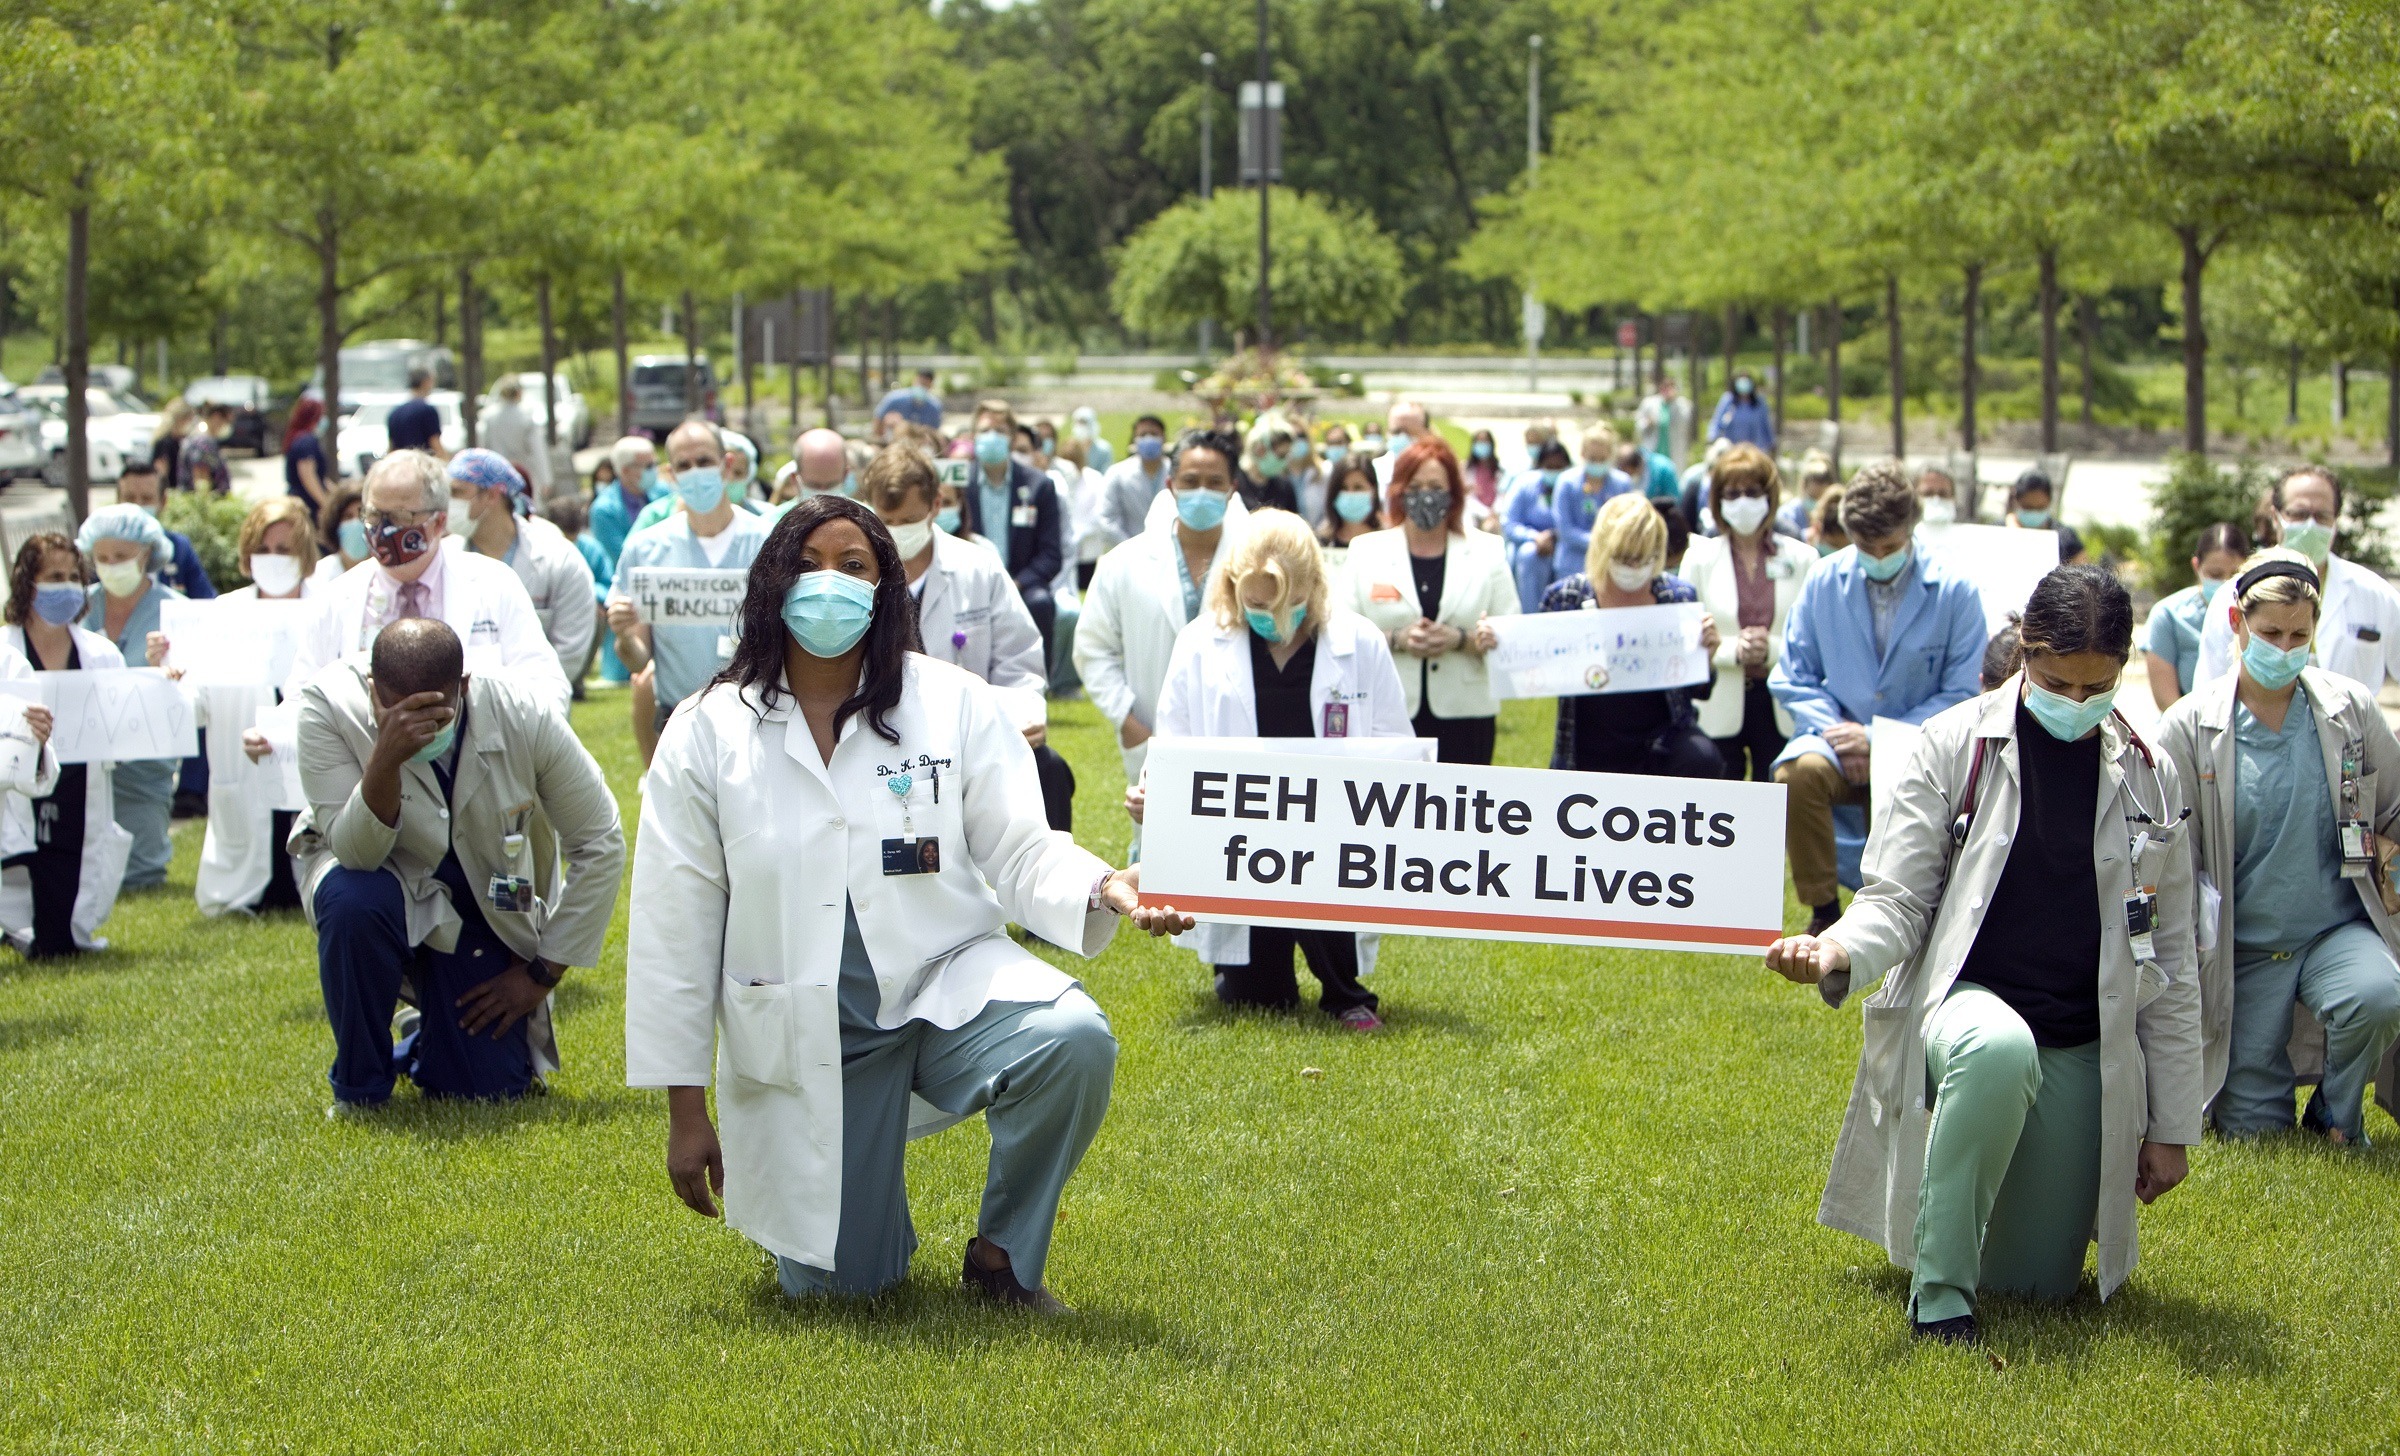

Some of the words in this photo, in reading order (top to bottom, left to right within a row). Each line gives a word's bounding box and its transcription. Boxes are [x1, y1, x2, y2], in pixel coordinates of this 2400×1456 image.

[656, 577, 742, 592] WHITECOA
[641, 592, 657, 621] 4
[665, 595, 742, 617] BLACKLIV
[877, 764, 897, 776] Dr.
[901, 758, 916, 773] K.
[918, 754, 952, 769] Darey
[1191, 771, 1318, 823] EEH
[1343, 780, 1532, 836] White
[1556, 793, 1736, 848] Coats
[1223, 834, 1315, 885] for
[1337, 843, 1512, 898] Black
[1534, 854, 1695, 909] Lives
